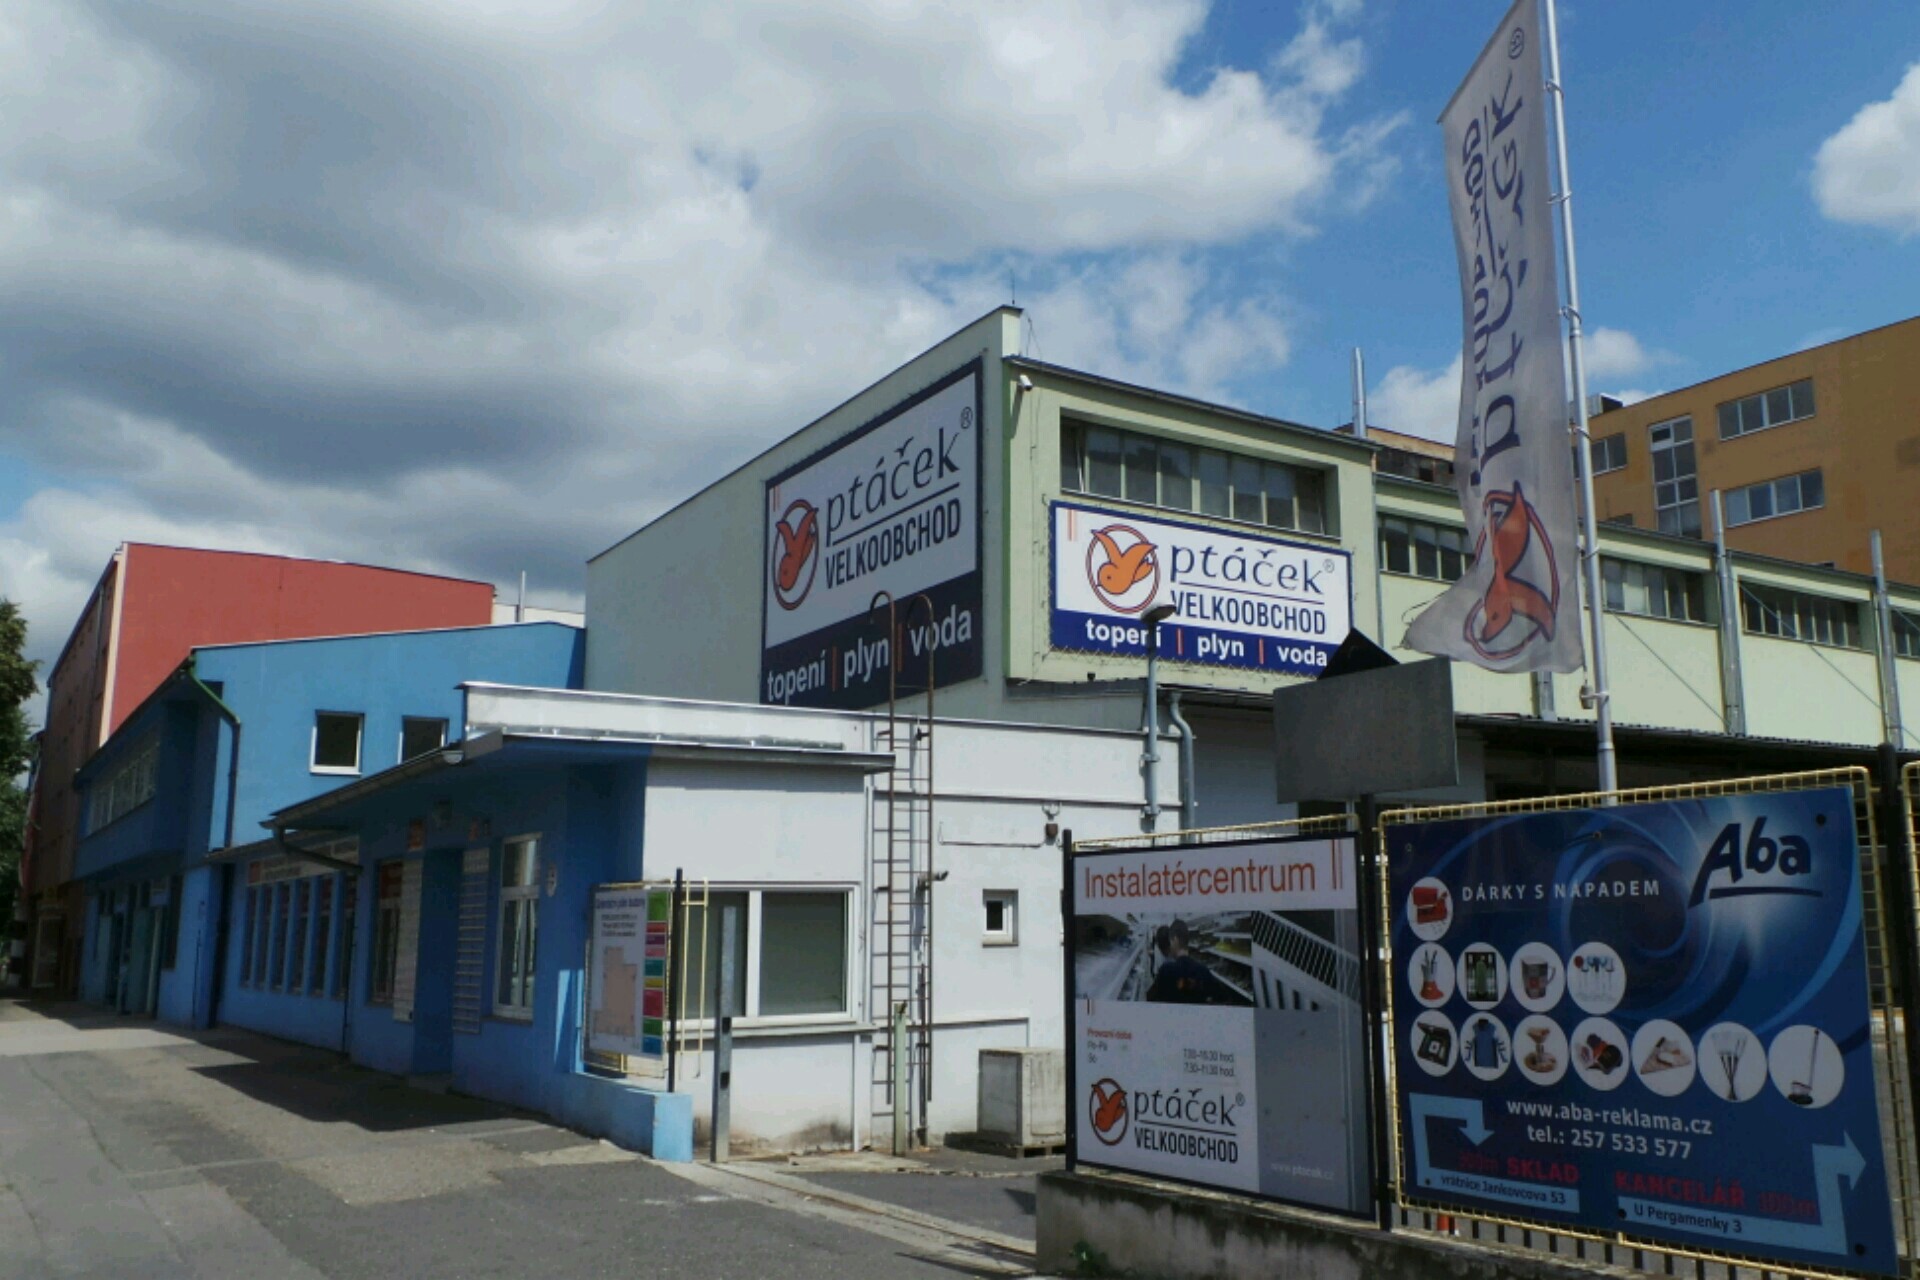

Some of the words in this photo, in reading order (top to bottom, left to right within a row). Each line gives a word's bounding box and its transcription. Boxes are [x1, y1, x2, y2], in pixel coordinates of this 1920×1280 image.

[826, 498, 961, 590] VELKOOBCHOD
[1170, 590, 1326, 635] VELKOOBCHOD
[767, 649, 826, 706] topení
[844, 637, 889, 689] plyn
[911, 604, 972, 657] voda
[1197, 633, 1244, 660] plyn
[1277, 644, 1328, 667] voda
[1085, 858, 1316, 899] Instalatércentrum
[1687, 816, 1812, 910] Aba
[1461, 881, 1526, 902] DÁRKY
[1534, 884, 1545, 899] S
[1506, 1100, 1713, 1135] www.aba-reklama.cz
[1134, 1127, 1239, 1164] VELKOOBCHOD
[1527, 1124, 1565, 1145] tel.:
[1570, 1128, 1605, 1149] 257
[1611, 1133, 1648, 1154] 533
[1654, 1138, 1692, 1159] 577
[1506, 1156, 1579, 1183] SKLAD
[1551, 1191, 1566, 1205] 53
[1614, 1170, 1744, 1207] KANCELÁŘ
[1633, 1203, 1644, 1216] U
[1647, 1206, 1728, 1234] Pergamenky
[1733, 1219, 1743, 1233] 3
